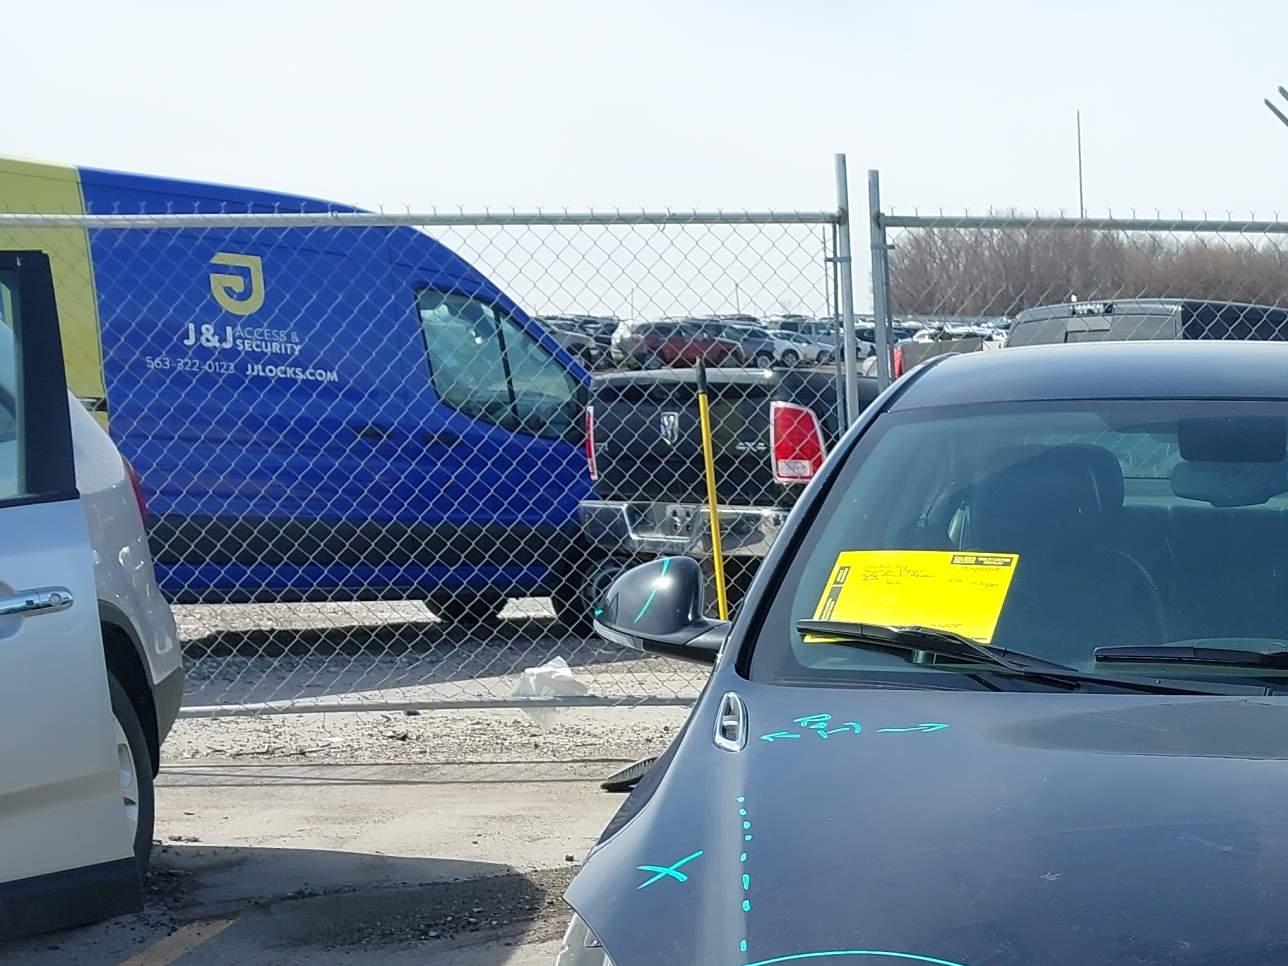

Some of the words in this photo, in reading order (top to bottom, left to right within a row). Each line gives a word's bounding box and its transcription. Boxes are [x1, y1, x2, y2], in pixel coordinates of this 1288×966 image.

[235, 327, 288, 342] ACCESS
[290, 331, 300, 342] &
[235, 339, 301, 355] SECURITY
[145, 356, 236, 374] 563-322-0123
[245, 363, 339, 382] JJLOCKS.COM
